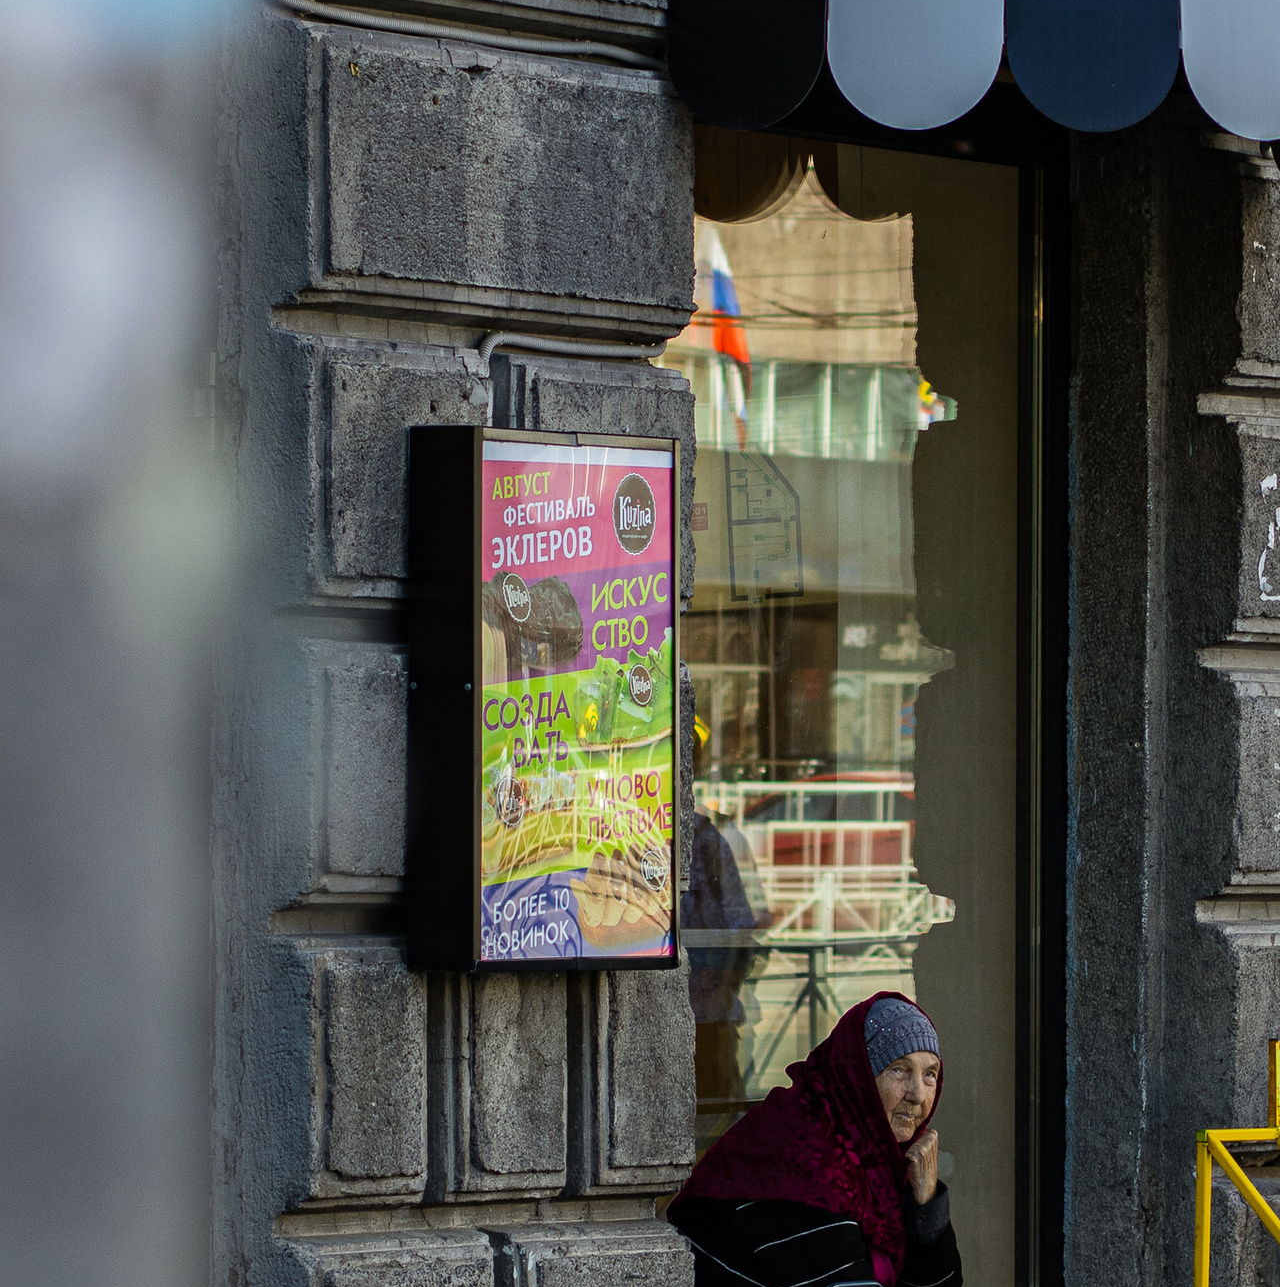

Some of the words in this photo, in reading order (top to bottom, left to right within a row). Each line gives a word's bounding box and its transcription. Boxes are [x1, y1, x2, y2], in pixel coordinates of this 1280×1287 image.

[492, 471, 551, 500] АВГУСТ
[503, 496, 596, 527] ФЕСТИВАЛЬ
[618, 496, 652, 531] Kuzina
[491, 526, 593, 569] ЭКЛЕРОВ
[591, 572, 668, 614] ИСКУС
[591, 614, 649, 651] СТВО
[483, 690, 571, 732] СОЗДА
[513, 730, 569, 768] ВАТЬ
[587, 770, 662, 810] УДОВО
[586, 802, 673, 845] ЛЬСТВИЕ
[493, 892, 547, 924] БОЛЕЕ
[554, 888, 570, 912] 10
[485, 919, 570, 958] НОВИНОК
